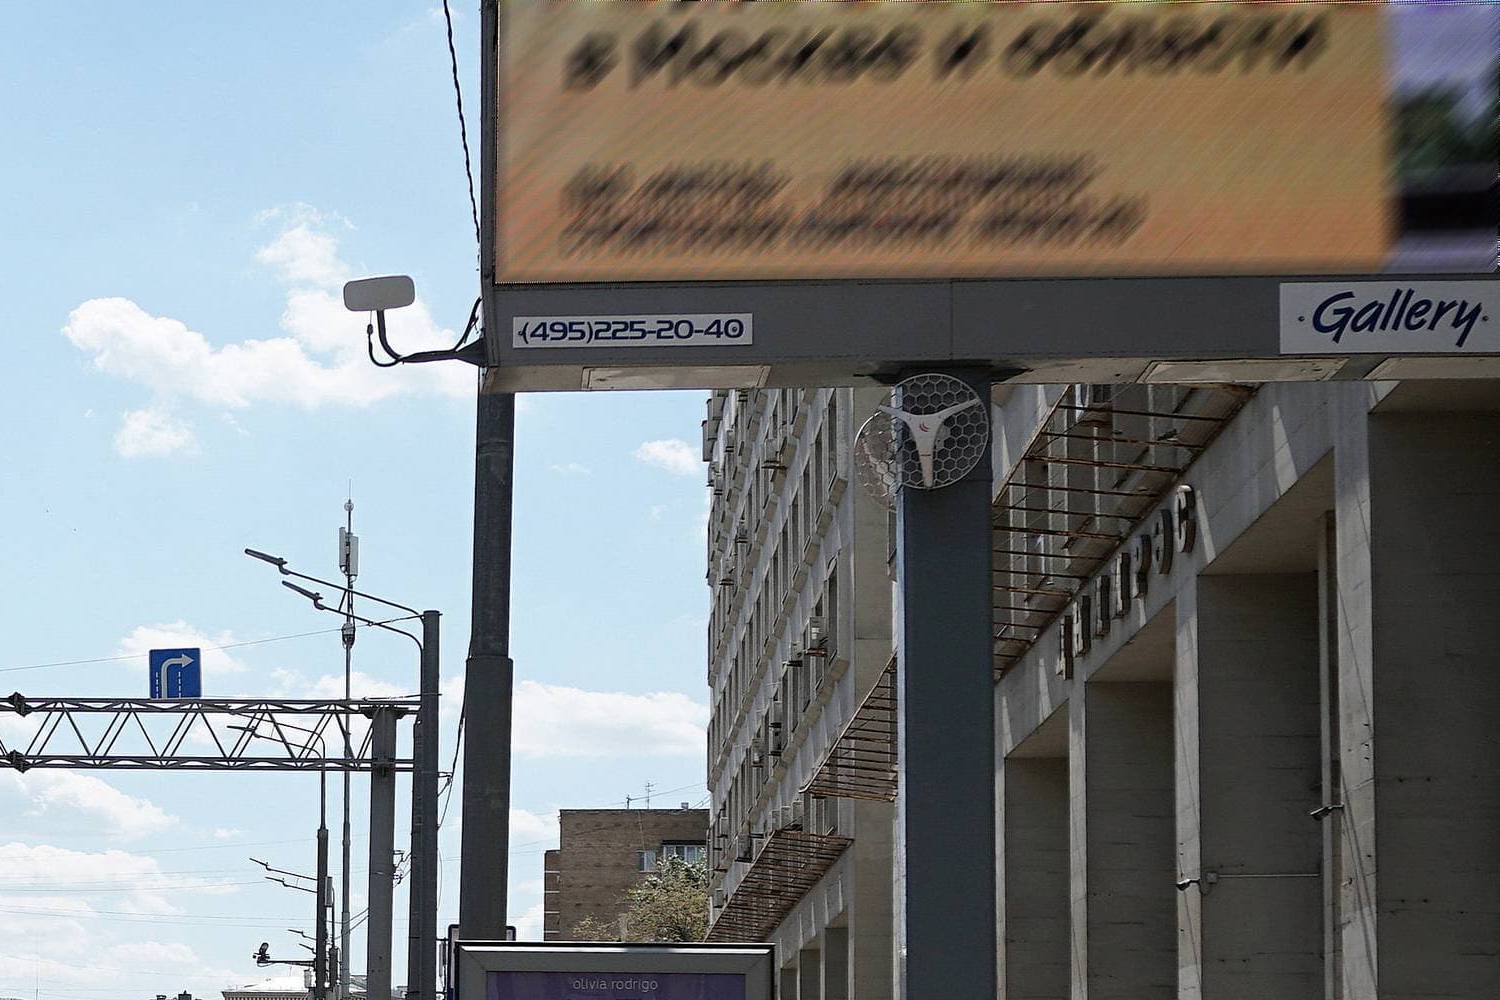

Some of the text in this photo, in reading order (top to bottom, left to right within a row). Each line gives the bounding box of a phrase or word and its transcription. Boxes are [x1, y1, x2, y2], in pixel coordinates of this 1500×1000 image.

[1312, 288, 1482, 348] Gallery
[522, 319, 744, 344] (495)225-20-40
[573, 979, 658, 992] olivia rodrigo
